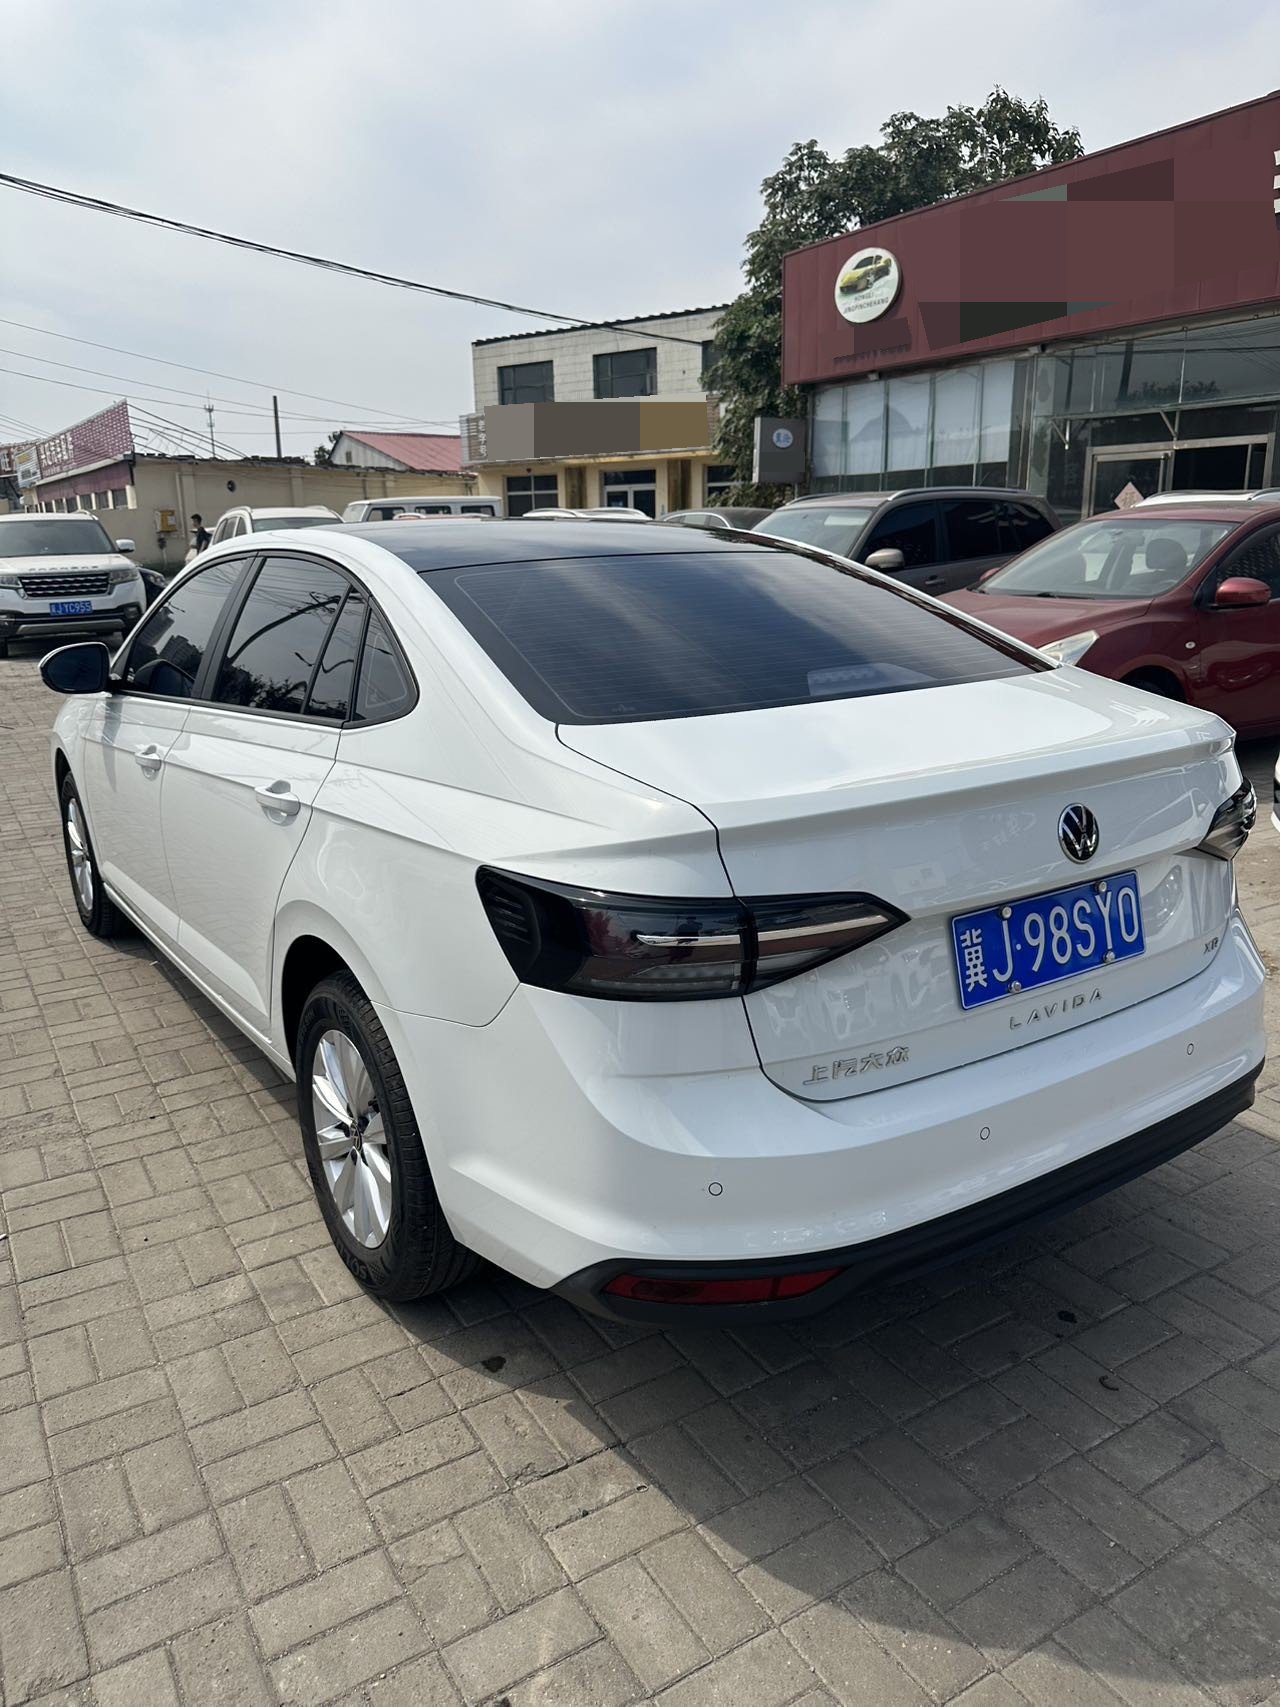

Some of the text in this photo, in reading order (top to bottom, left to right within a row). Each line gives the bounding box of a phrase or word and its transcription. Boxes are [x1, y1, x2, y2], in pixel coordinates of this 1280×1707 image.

[1009, 988, 1103, 1030] LAVIDA
[802, 1045, 910, 1086] 上汽大众
